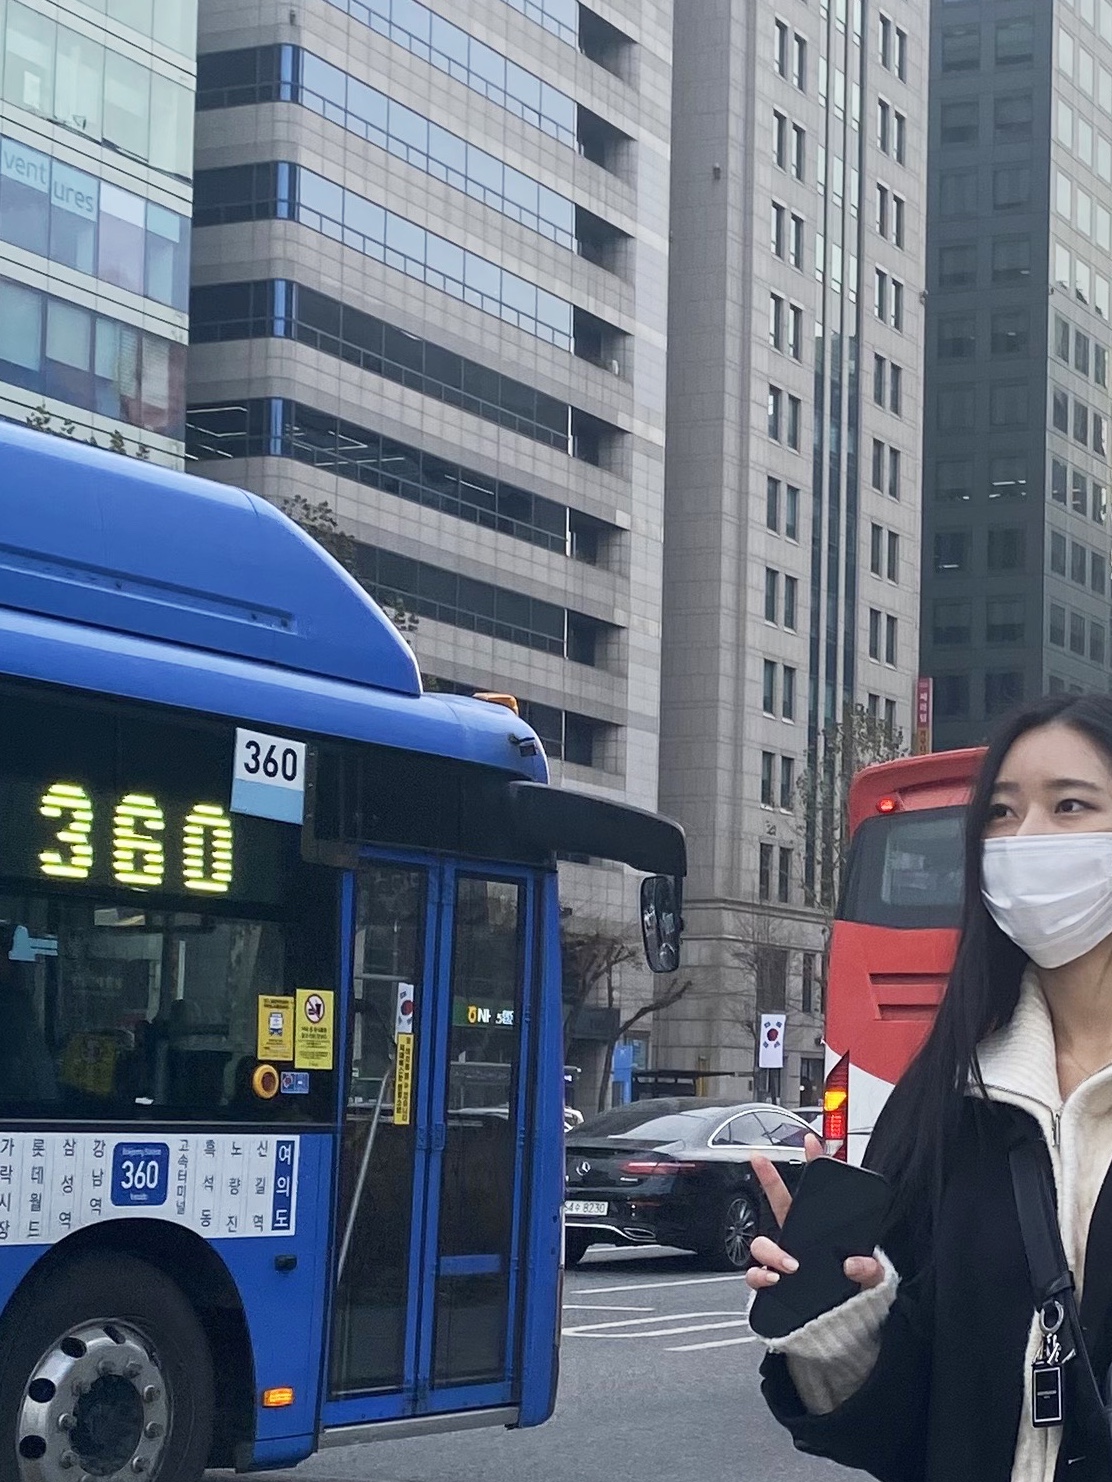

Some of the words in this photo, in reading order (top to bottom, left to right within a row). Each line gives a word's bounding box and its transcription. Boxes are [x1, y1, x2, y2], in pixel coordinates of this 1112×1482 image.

[3, 150, 95, 213] ventures
[243, 740, 298, 782] 360
[38, 782, 234, 894] 360
[0, 1138, 15, 1241] 가락시장
[27, 1138, 46, 1239] 롯데월드
[58, 1138, 77, 1230] 삼성역
[89, 1139, 107, 1216] 강남역
[120, 1160, 160, 1190] 360
[176, 1139, 190, 1216] 고속터미널
[200, 1139, 216, 1228] 흑석동
[226, 1141, 243, 1233] 노량진
[253, 1140, 269, 1232] 신길역
[273, 1143, 293, 1228] 여의도
